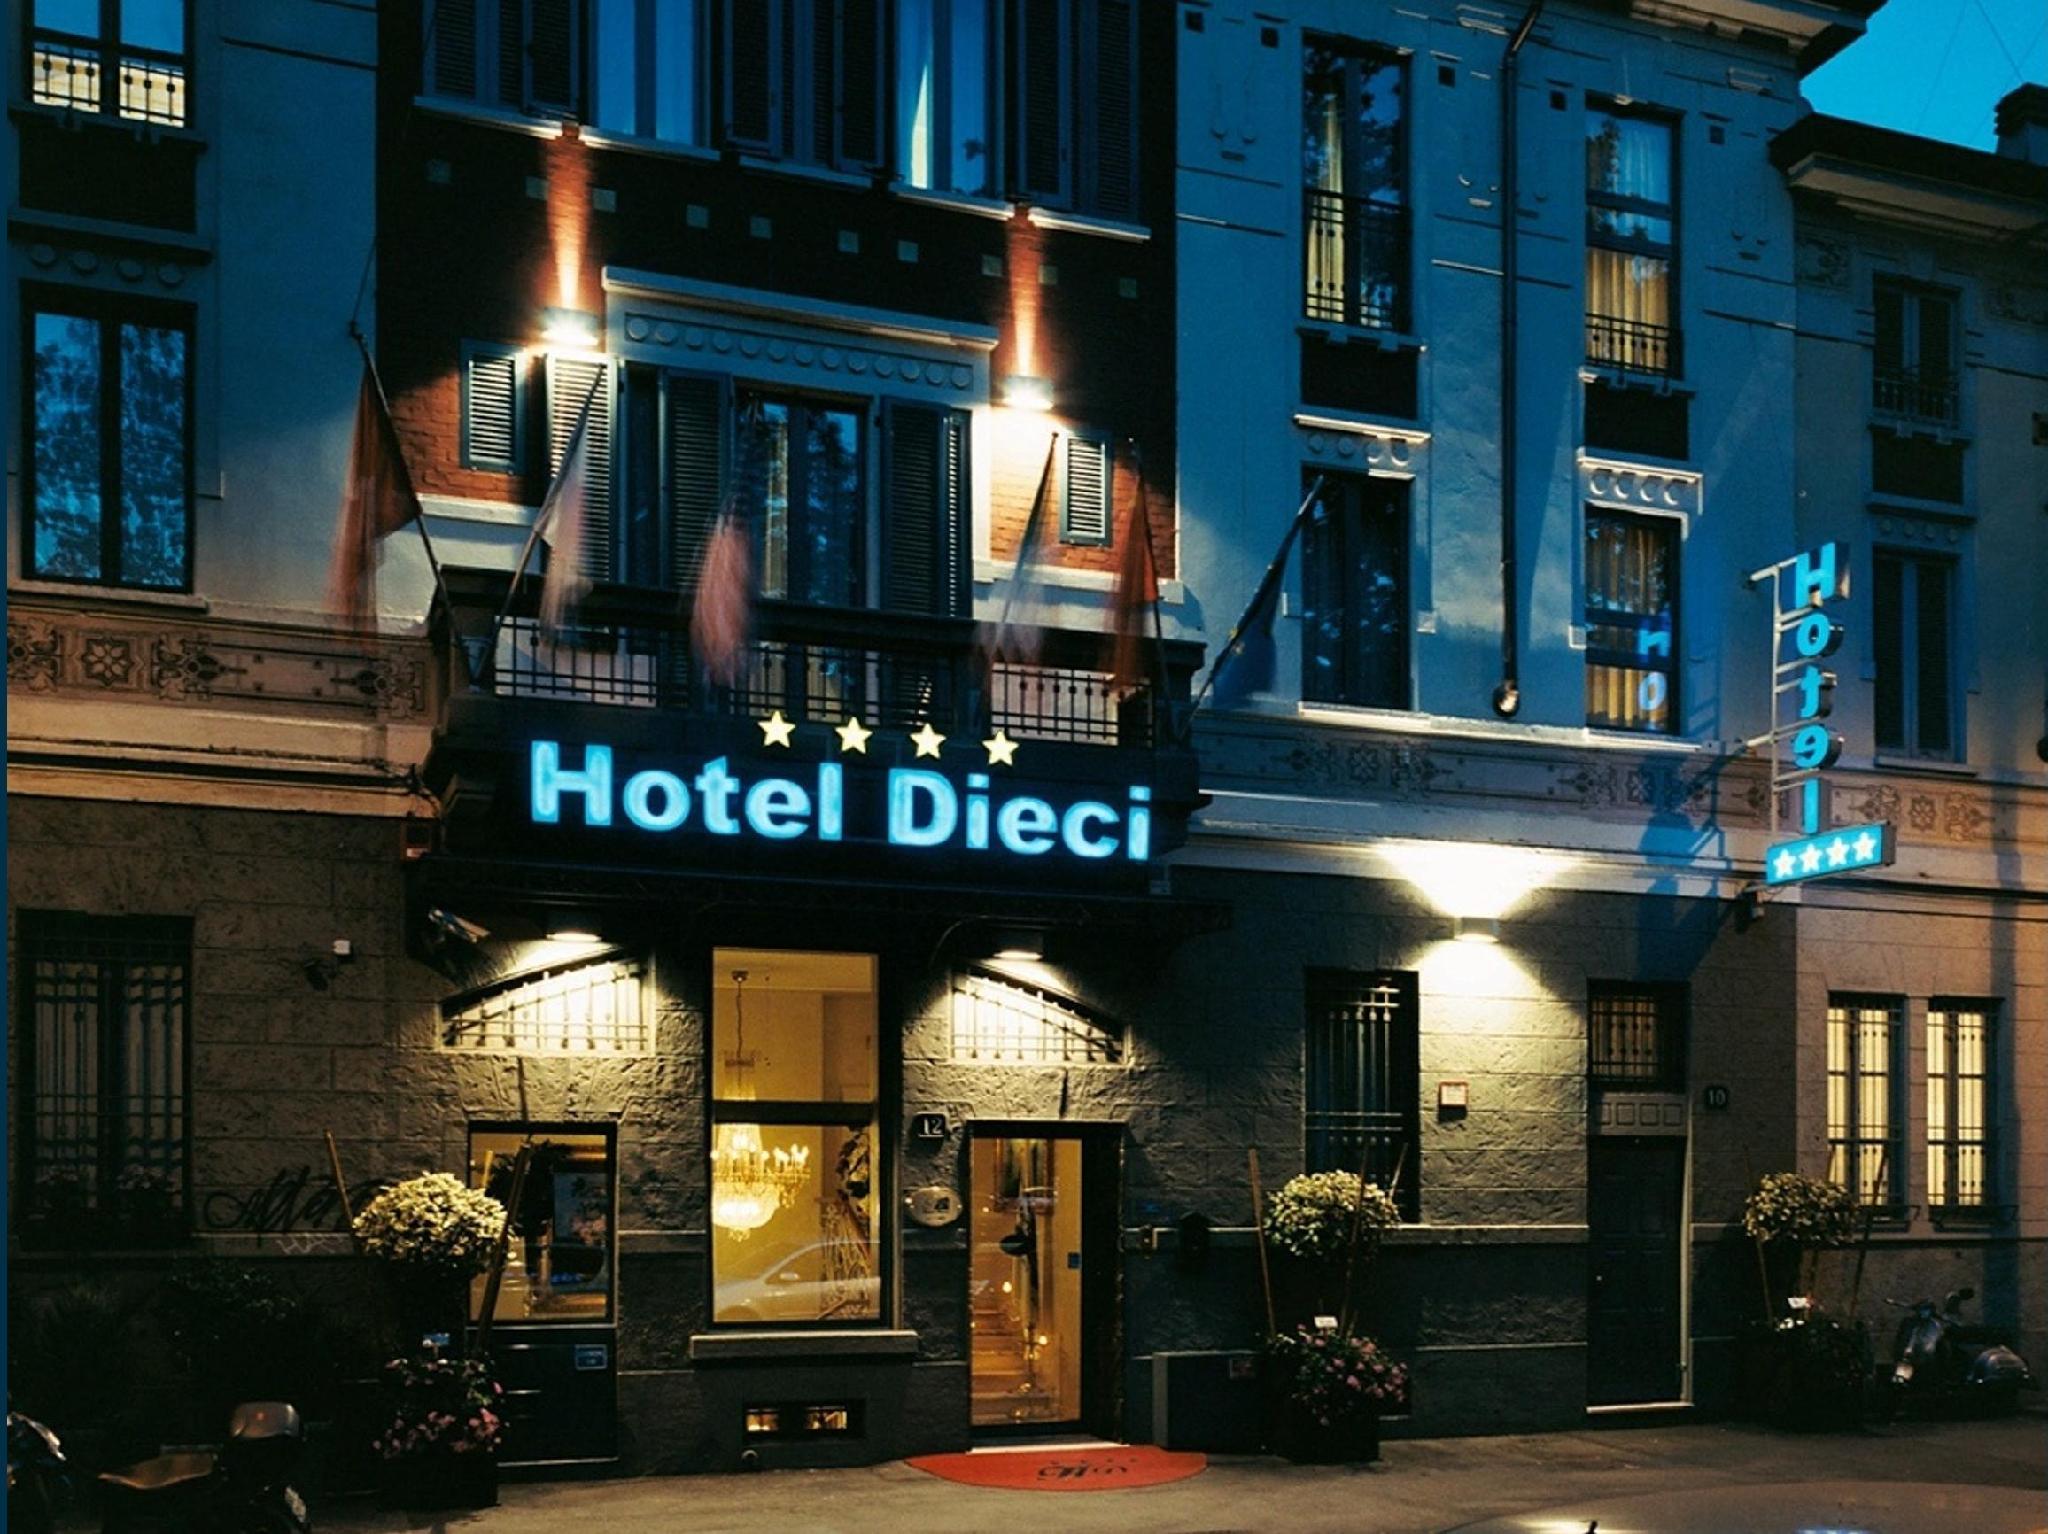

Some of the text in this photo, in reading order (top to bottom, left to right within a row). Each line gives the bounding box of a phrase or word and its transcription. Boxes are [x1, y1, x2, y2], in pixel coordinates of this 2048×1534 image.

[1793, 541, 1836, 834] Hotel
[529, 739, 1152, 860] Hotel Dieci
[923, 1116, 944, 1135] 12
[1708, 1088, 1727, 1105] 10
